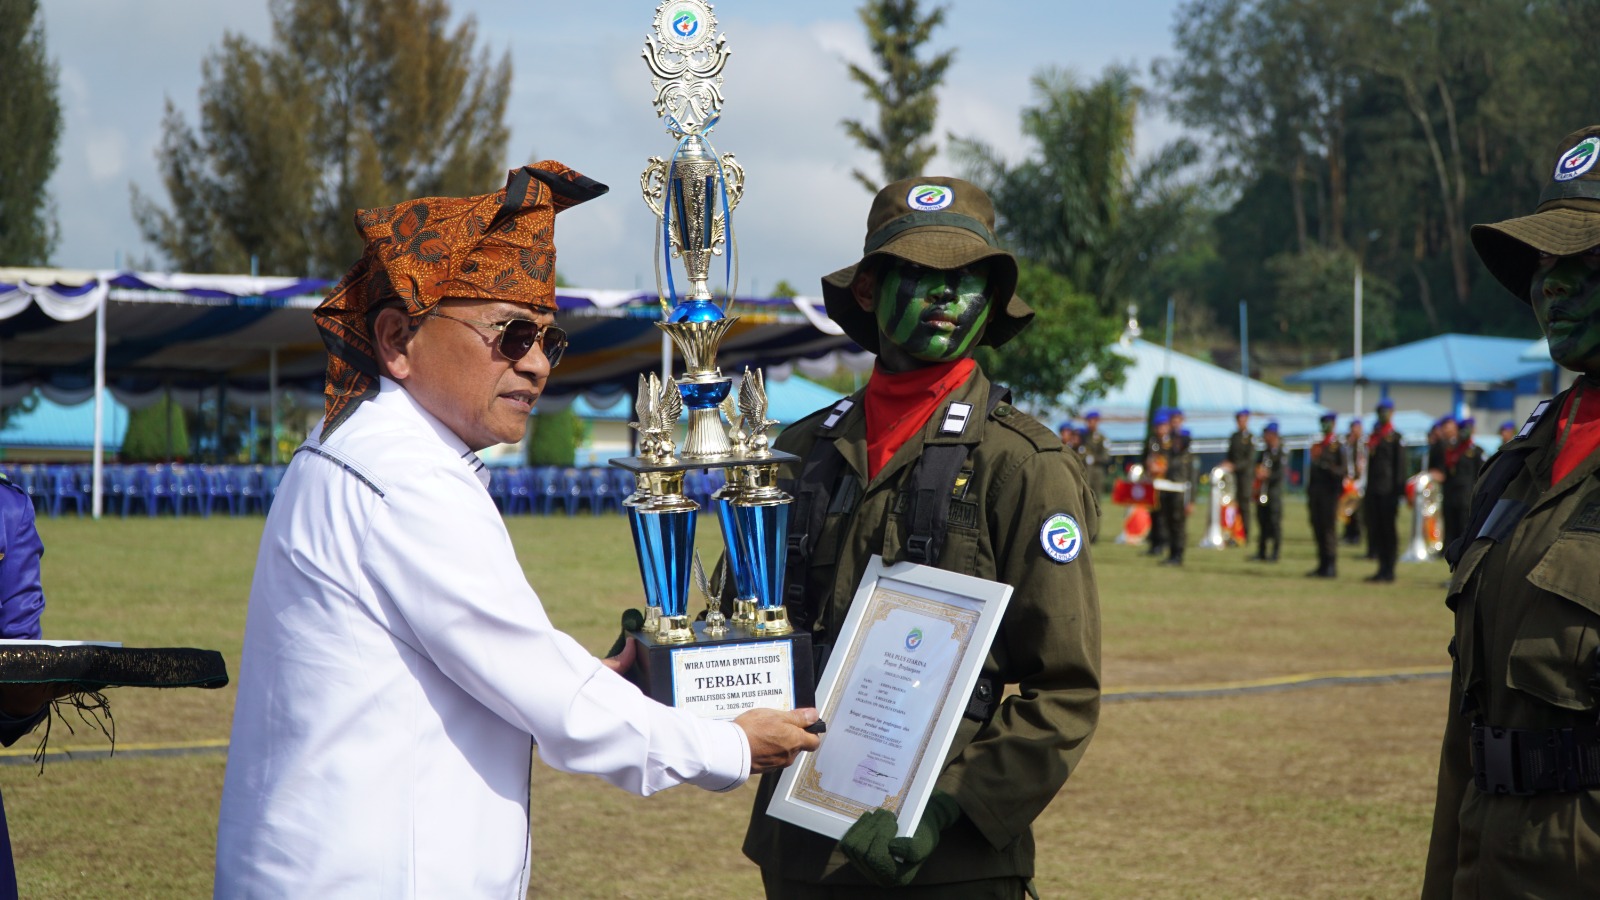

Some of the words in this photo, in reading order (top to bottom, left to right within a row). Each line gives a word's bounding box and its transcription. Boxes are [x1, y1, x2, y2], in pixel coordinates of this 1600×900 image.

[685, 660, 704, 670] WIRA
[706, 658, 731, 668] UTAMA
[695, 672, 762, 689] TERBAIK
[766, 672, 772, 683] I
[685, 693, 726, 703] BINTALFISDIS
[727, 691, 740, 699] SMA
[741, 690, 756, 698] PLUS
[757, 689, 783, 697] EFARINA
